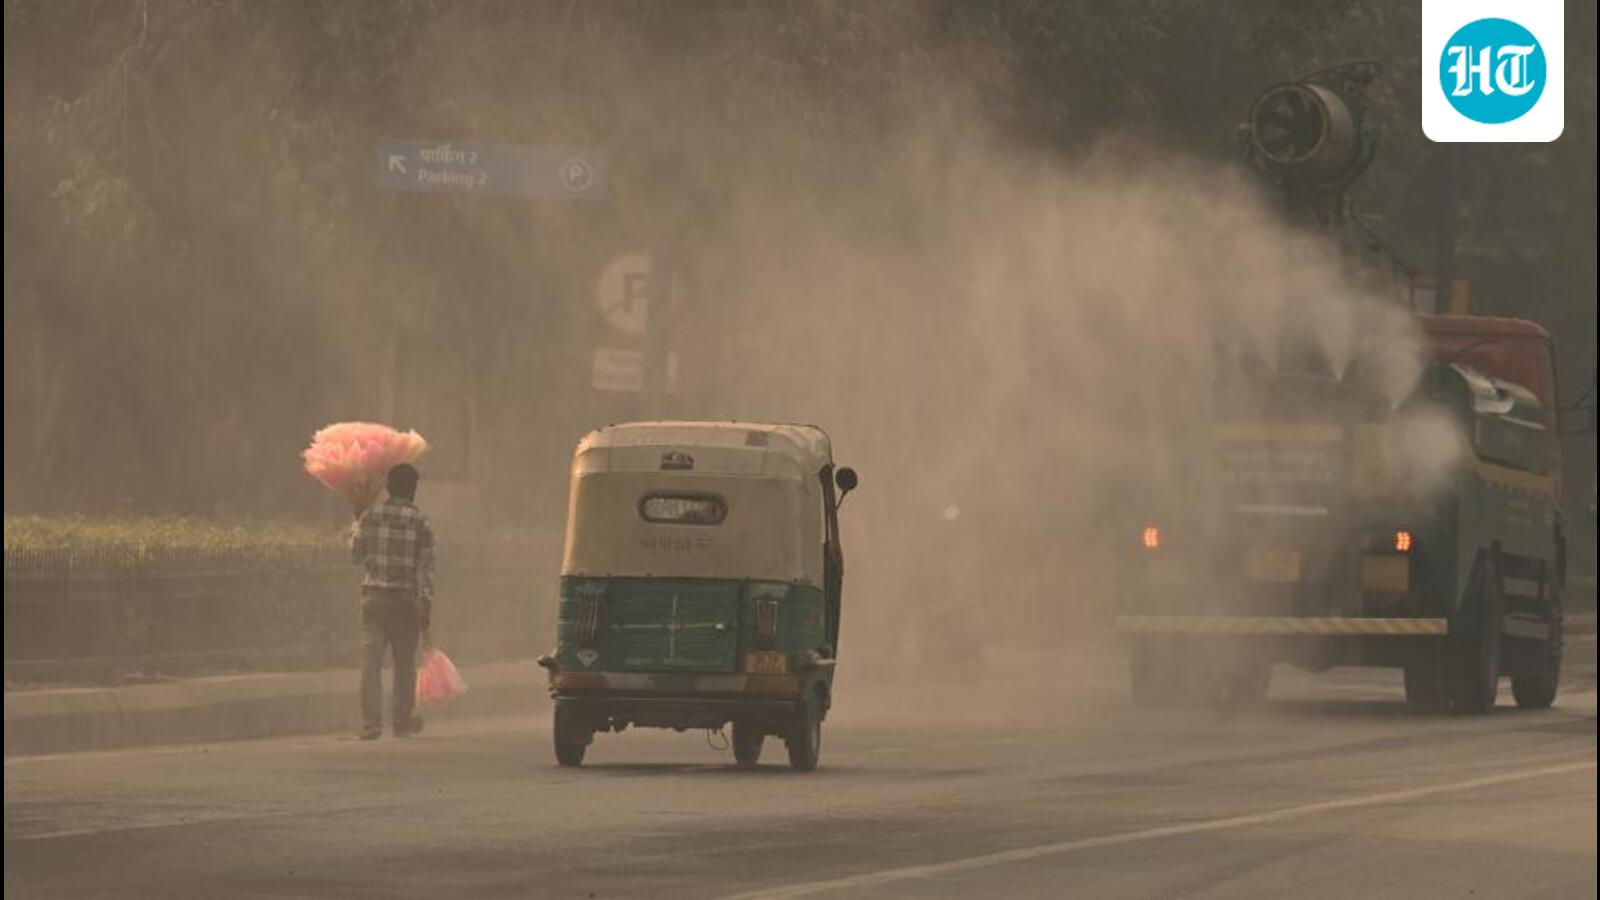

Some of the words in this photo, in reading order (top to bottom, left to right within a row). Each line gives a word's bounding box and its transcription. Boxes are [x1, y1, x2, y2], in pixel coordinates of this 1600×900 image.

[417, 168, 474, 188] Parking
[476, 172, 488, 186] 2
[569, 164, 583, 183] P
